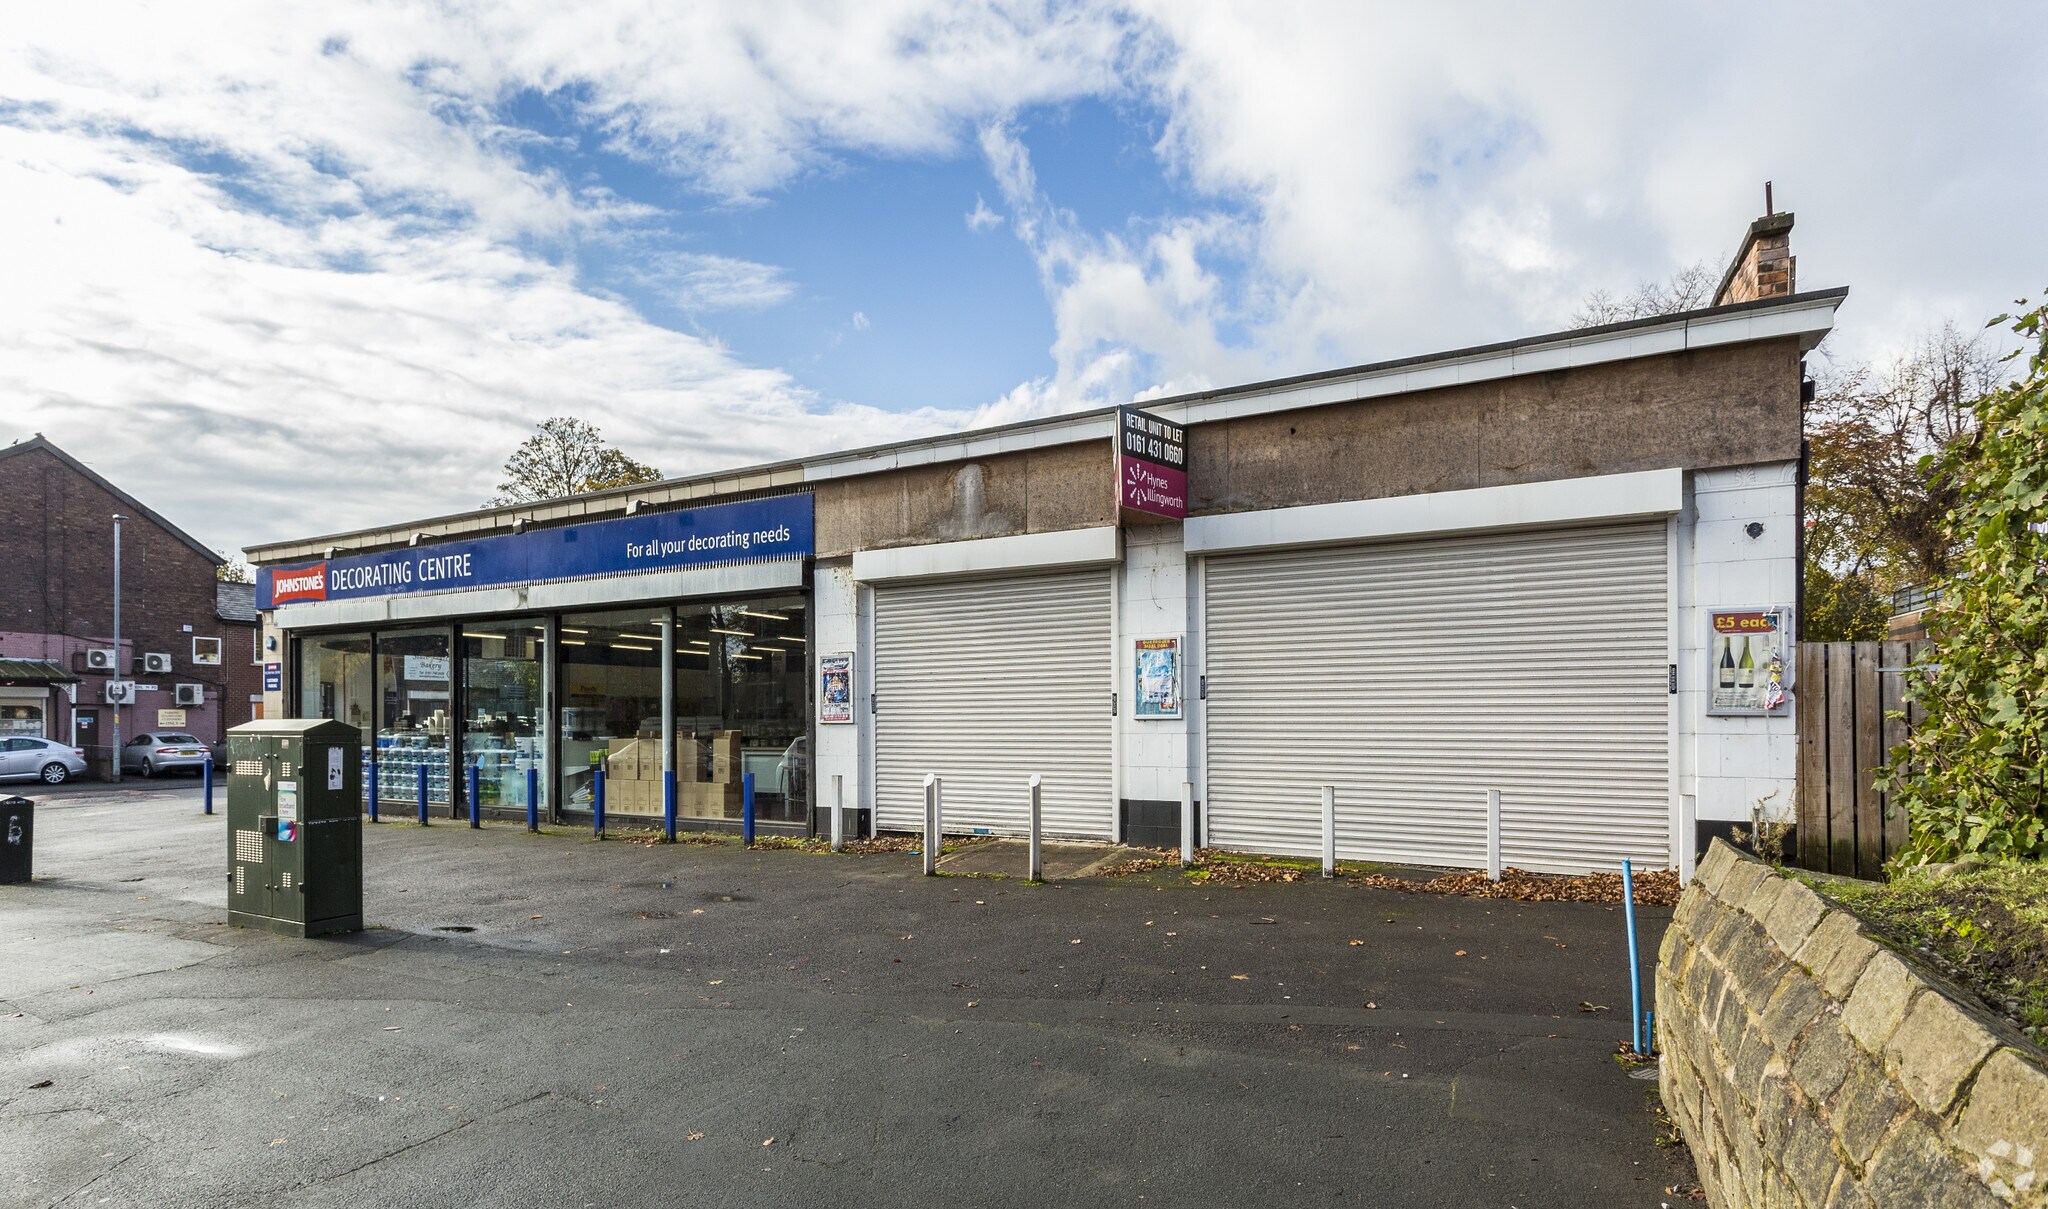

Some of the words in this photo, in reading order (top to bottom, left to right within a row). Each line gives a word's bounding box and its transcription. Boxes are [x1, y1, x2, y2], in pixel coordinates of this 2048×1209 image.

[1126, 412, 1147, 432] RETAIL
[1148, 420, 1162, 436] UNIT
[1163, 425, 1171, 440] TO
[1172, 427, 1183, 443] LET
[1126, 431, 1146, 454] 0161
[1147, 438, 1162, 459] 431
[1164, 443, 1183, 465] 0660
[1147, 472, 1168, 489] Hynes
[1147, 488, 1183, 508] Illingworth
[626, 542, 643, 558] For
[645, 539, 659, 556] all
[661, 539, 686, 558] your
[688, 530, 750, 551] decorating
[753, 524, 790, 544] needs
[275, 570, 324, 599] JOHNSTONE'S
[331, 561, 412, 592] DECORATING
[418, 553, 472, 582] CENTRE
[1716, 617, 1735, 629] £5
[1740, 618, 1772, 628] eac
[420, 662, 442, 671] Bakery
